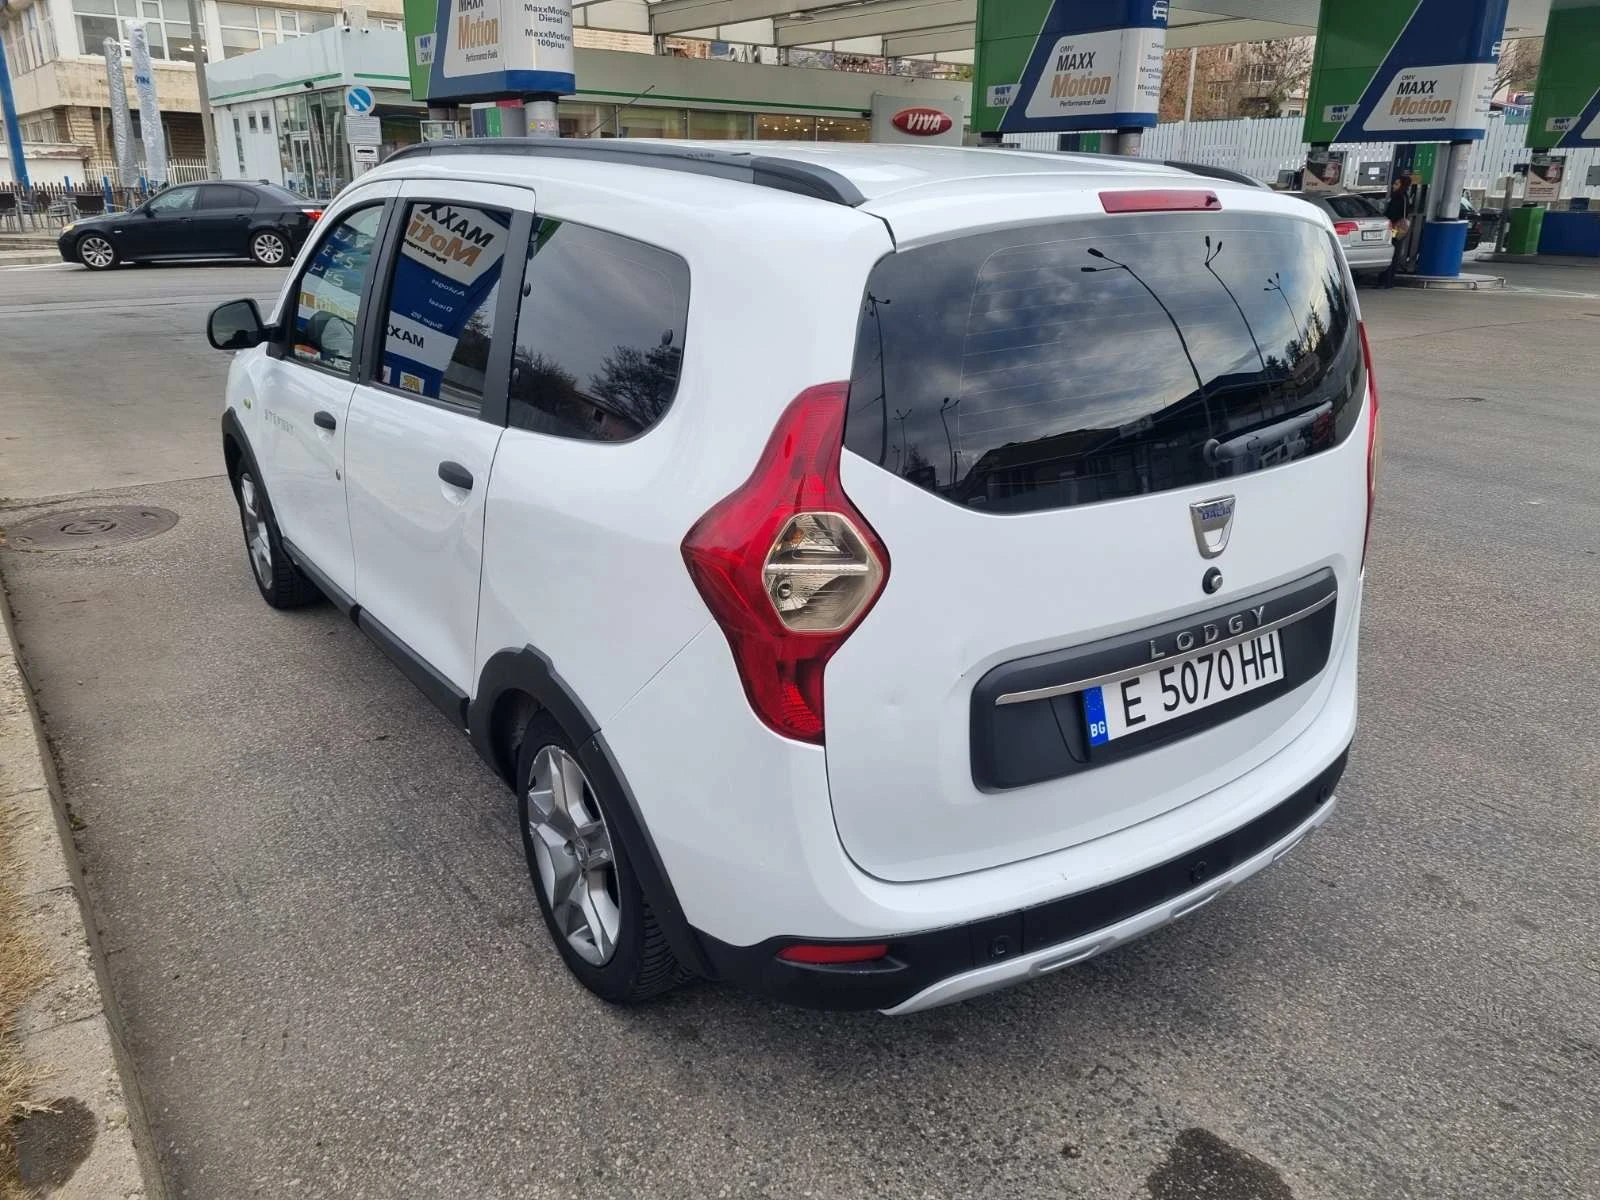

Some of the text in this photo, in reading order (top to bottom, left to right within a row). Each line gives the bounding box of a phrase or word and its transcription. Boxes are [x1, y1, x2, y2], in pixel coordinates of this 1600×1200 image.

[538, 13, 563, 24] Diesel
[458, 11, 498, 50] Motion
[537, 38, 566, 49] 100plus
[1060, 45, 1075, 53] OMV
[1056, 51, 1096, 71] MAXX
[1050, 70, 1112, 98] Motion
[1396, 80, 1438, 95] MAXX
[1390, 95, 1453, 115] Motion
[906, 112, 942, 131] VIVA
[1202, 506, 1231, 520] DACIA
[1150, 605, 1264, 659] LODGY
[1121, 677, 1146, 727] E
[1090, 721, 1106, 737] BG
